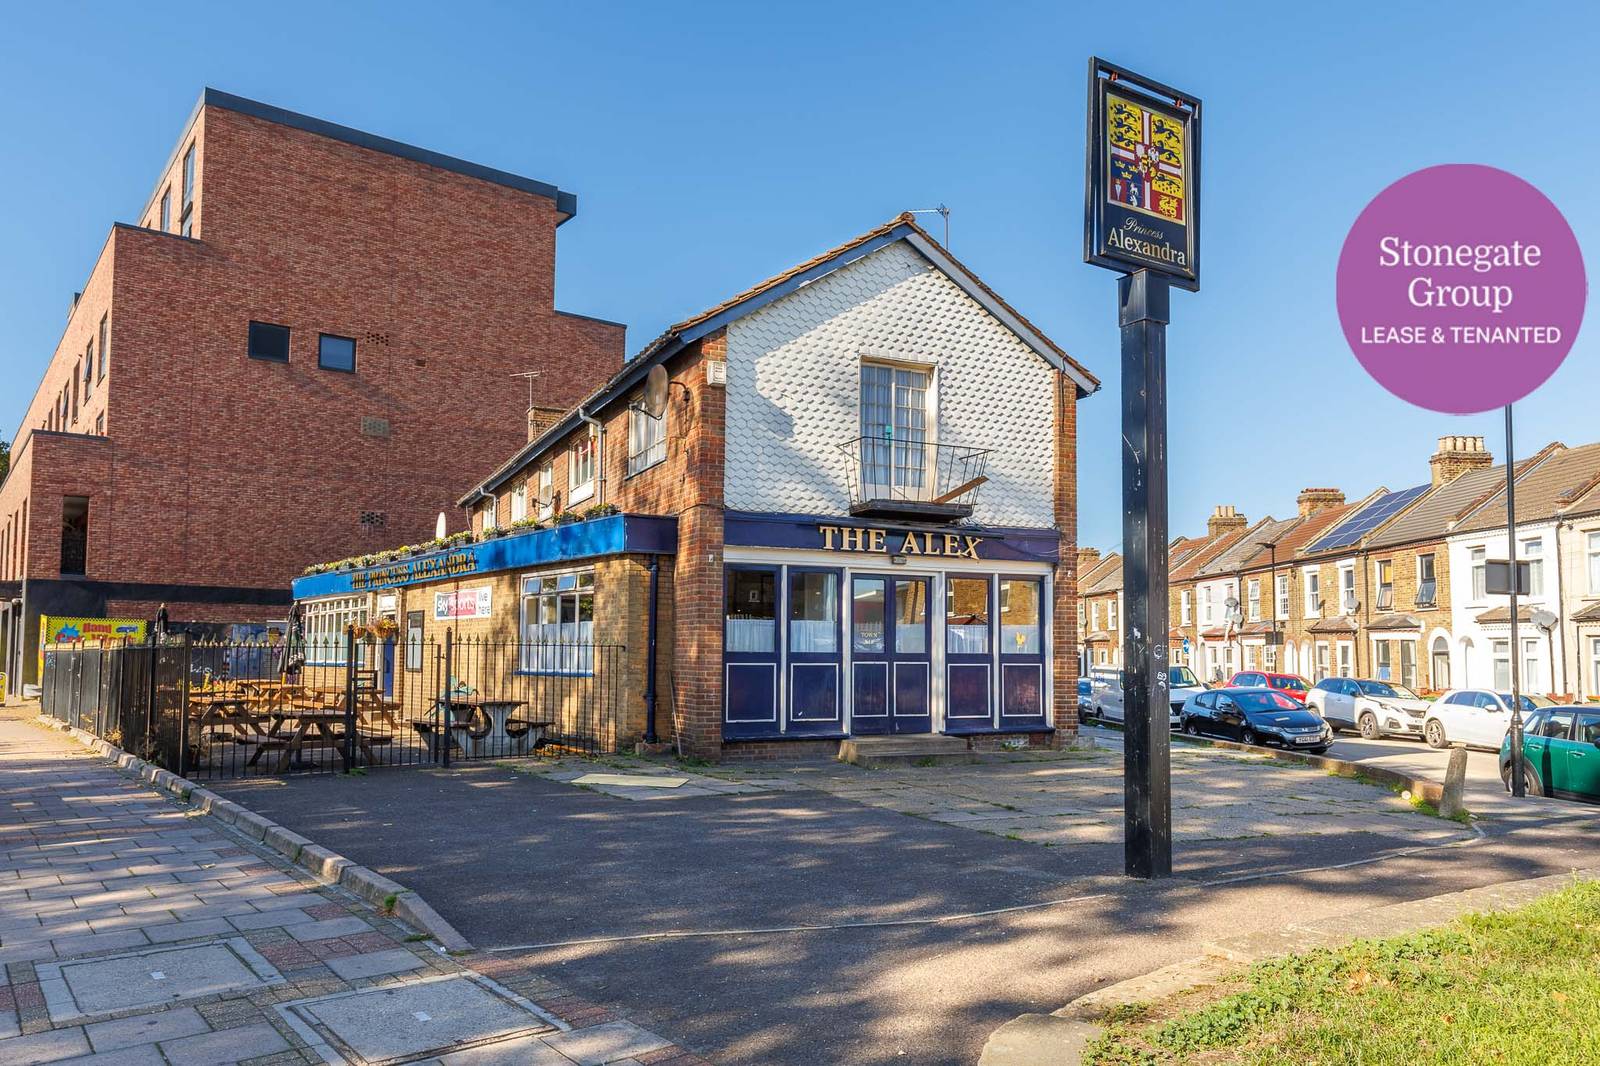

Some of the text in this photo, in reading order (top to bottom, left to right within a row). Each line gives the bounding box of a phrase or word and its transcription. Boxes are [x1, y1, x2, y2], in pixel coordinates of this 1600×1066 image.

[1124, 217, 1164, 239] Princess
[1107, 227, 1186, 266] Alexandra
[819, 525, 983, 560] THE ALEX
[352, 552, 477, 589] THE PRINCESS ALEXANDRA
[437, 596, 449, 616] sky
